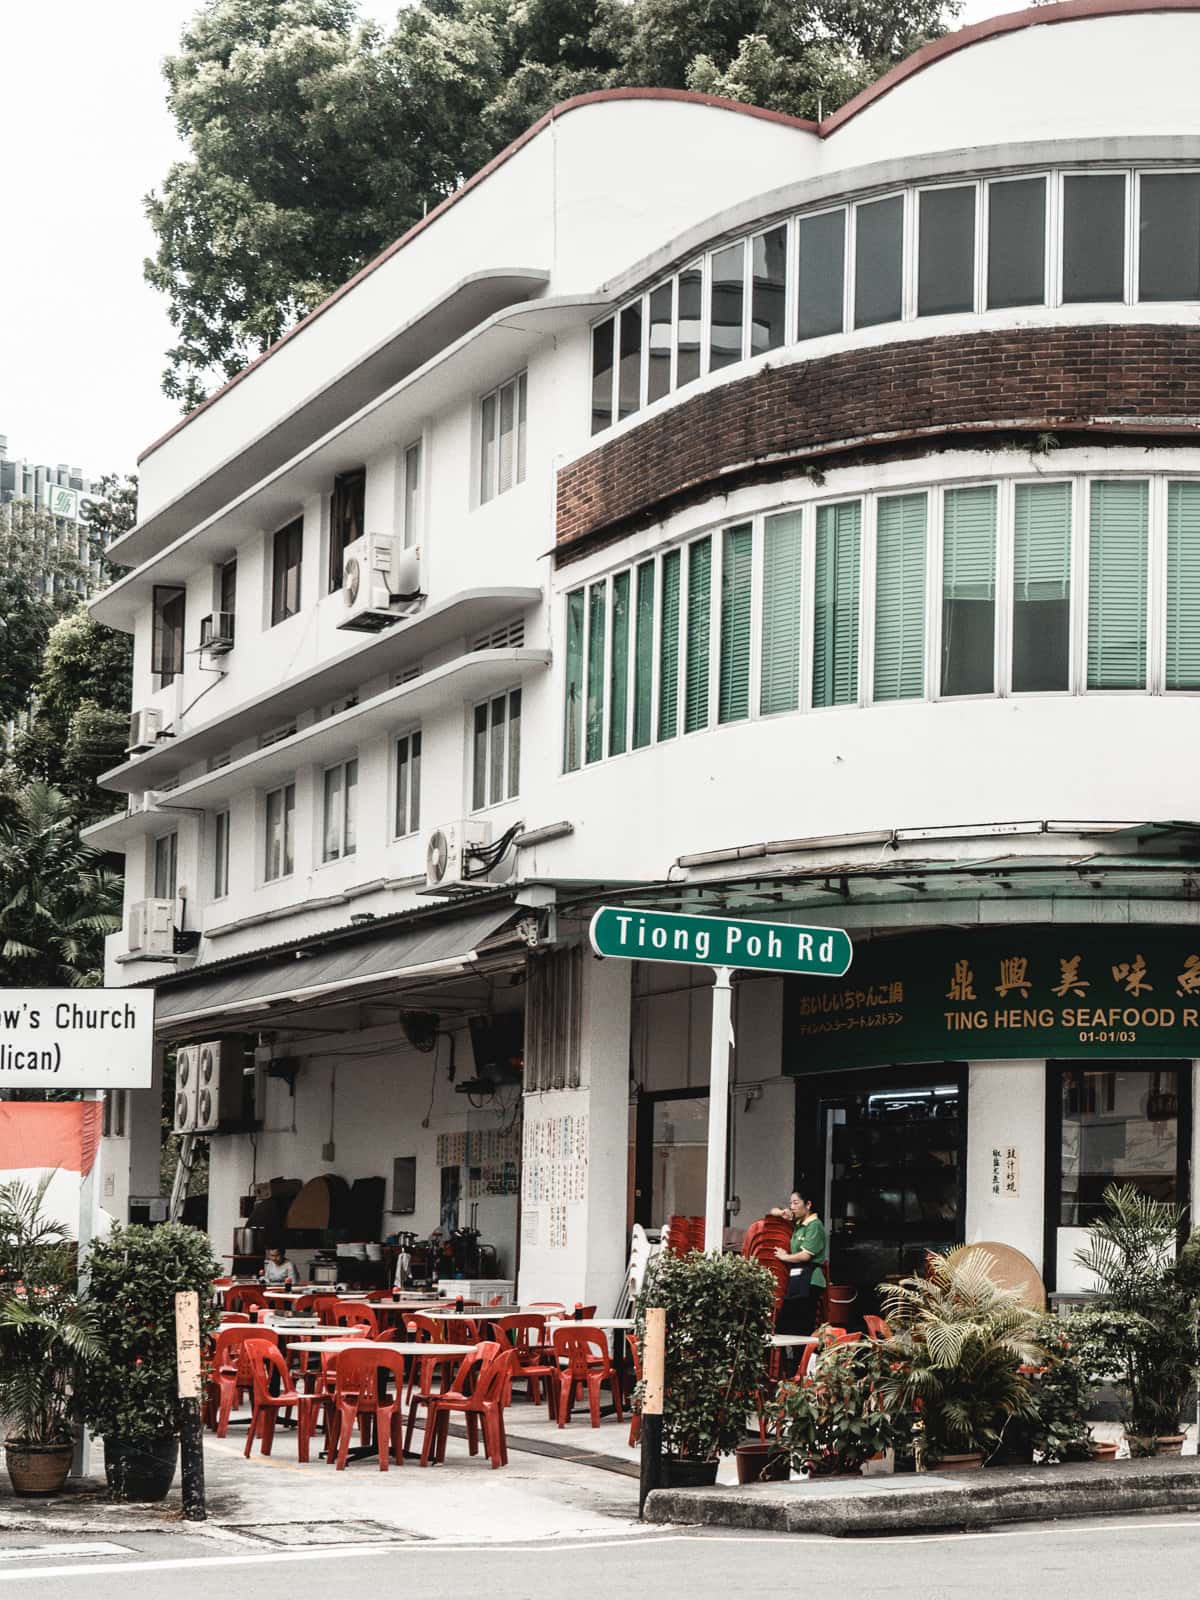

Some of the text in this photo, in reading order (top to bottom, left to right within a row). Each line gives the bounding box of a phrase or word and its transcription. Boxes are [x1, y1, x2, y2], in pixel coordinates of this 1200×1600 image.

[616, 916, 834, 963] Tiong Poh Rd
[0, 1003, 136, 1029] w's Church
[944, 1010, 988, 1030] TING
[994, 1008, 1054, 1029] HENG
[1062, 1008, 1175, 1027] SEAFOOD
[1079, 1031, 1137, 1042] 01-01/03
[0, 1042, 61, 1073] lican)
